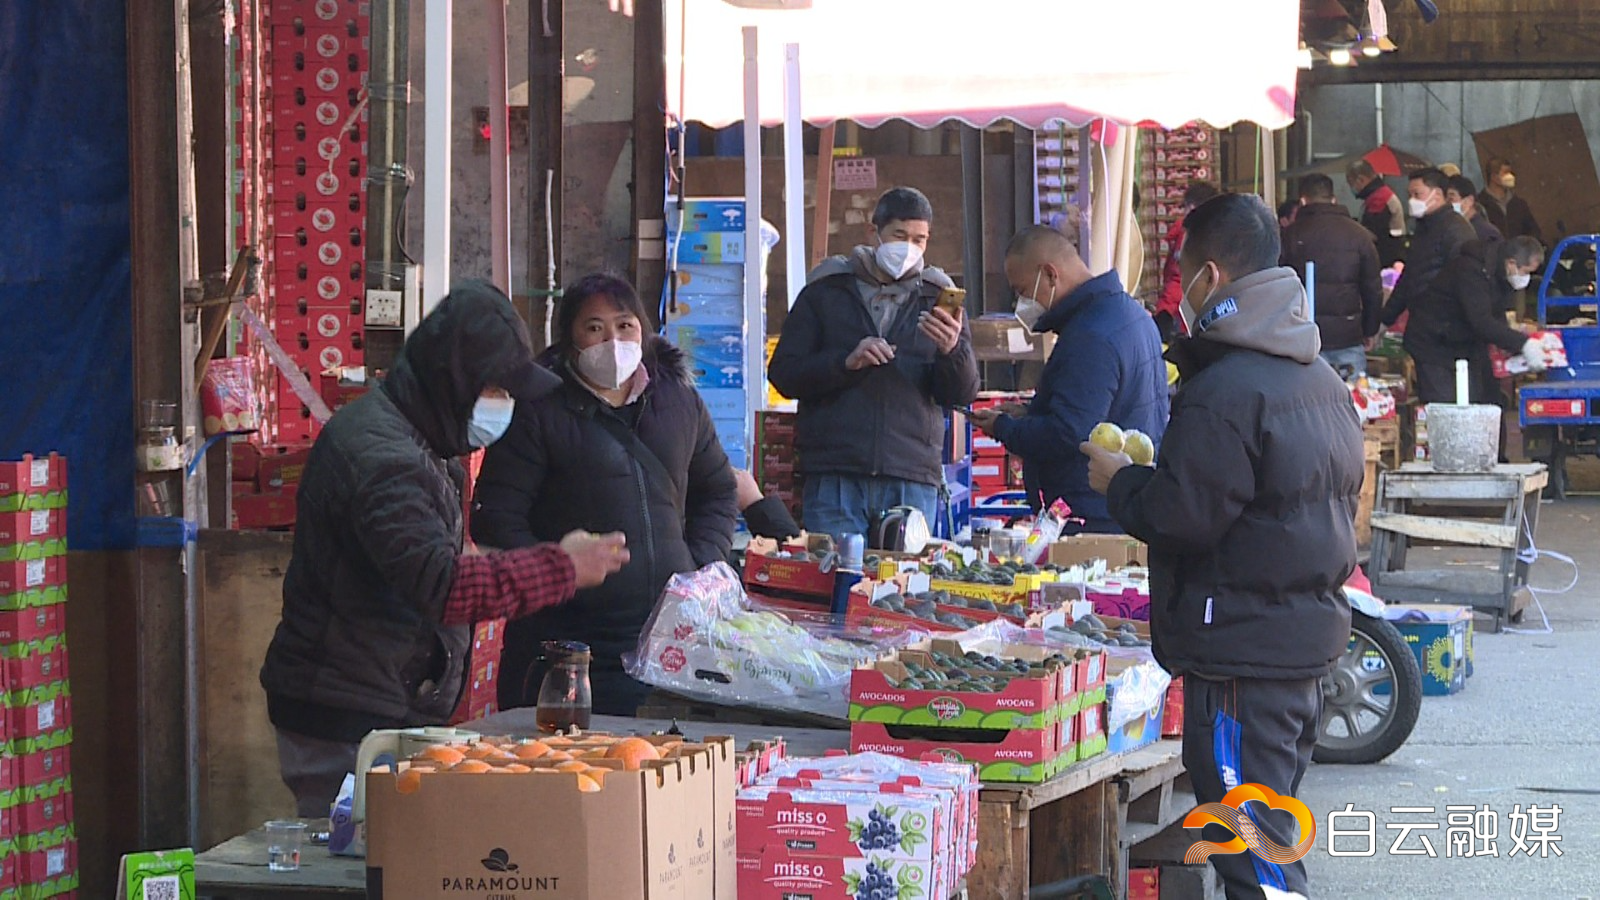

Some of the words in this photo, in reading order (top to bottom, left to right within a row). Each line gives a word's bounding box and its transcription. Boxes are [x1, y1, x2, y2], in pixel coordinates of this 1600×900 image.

[859, 692, 906, 702] AVOCADOS
[995, 698, 1035, 708] AVOCATS
[858, 743, 905, 754] AVOCADOS
[994, 750, 1034, 759] AVOCATS
[776, 807, 813, 824] miss
[776, 827, 799, 837] quality
[800, 829, 826, 837] produce
[773, 860, 810, 877] miss
[442, 877, 560, 891] PARAMOUNT
[773, 879, 796, 890] quality
[797, 881, 823, 890] produce
